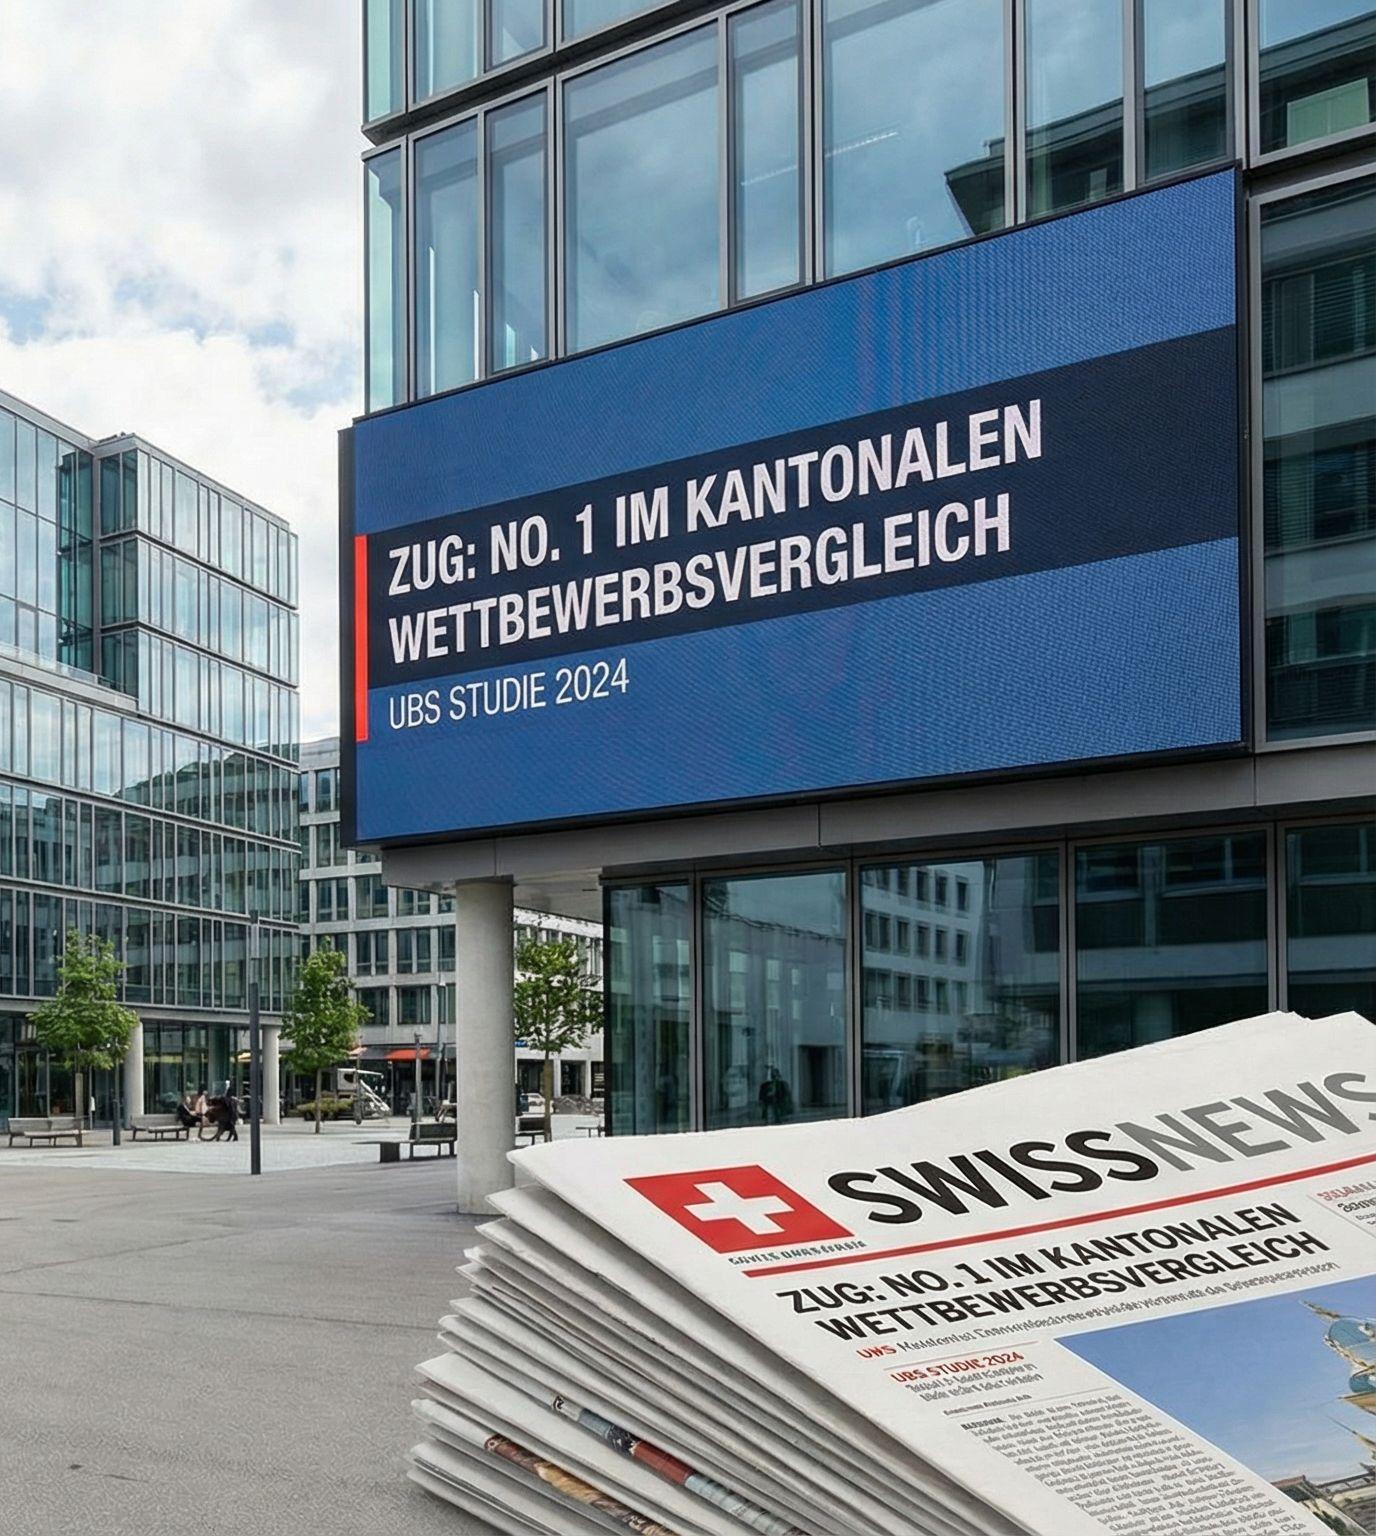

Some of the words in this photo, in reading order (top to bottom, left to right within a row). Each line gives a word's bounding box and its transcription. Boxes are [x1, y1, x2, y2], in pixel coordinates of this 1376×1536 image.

[388, 534, 477, 597] ZUG:
[490, 515, 561, 576] NO.
[575, 503, 593, 556] 1
[616, 485, 670, 549] IM
[686, 398, 1043, 533] KANTONALEN
[388, 492, 1011, 665] WETTBEWERBSVERGLEICH
[389, 685, 441, 731] UBS
[449, 671, 547, 722] STUDIE
[555, 657, 630, 711] 2024
[776, 1282, 887, 1315] ZUG:
[983, 1252, 1046, 1280] IM
[1037, 1202, 1302, 1270] KANTONALEN
[814, 1231, 1331, 1341] WETTBEWERBSVERGLEICH
